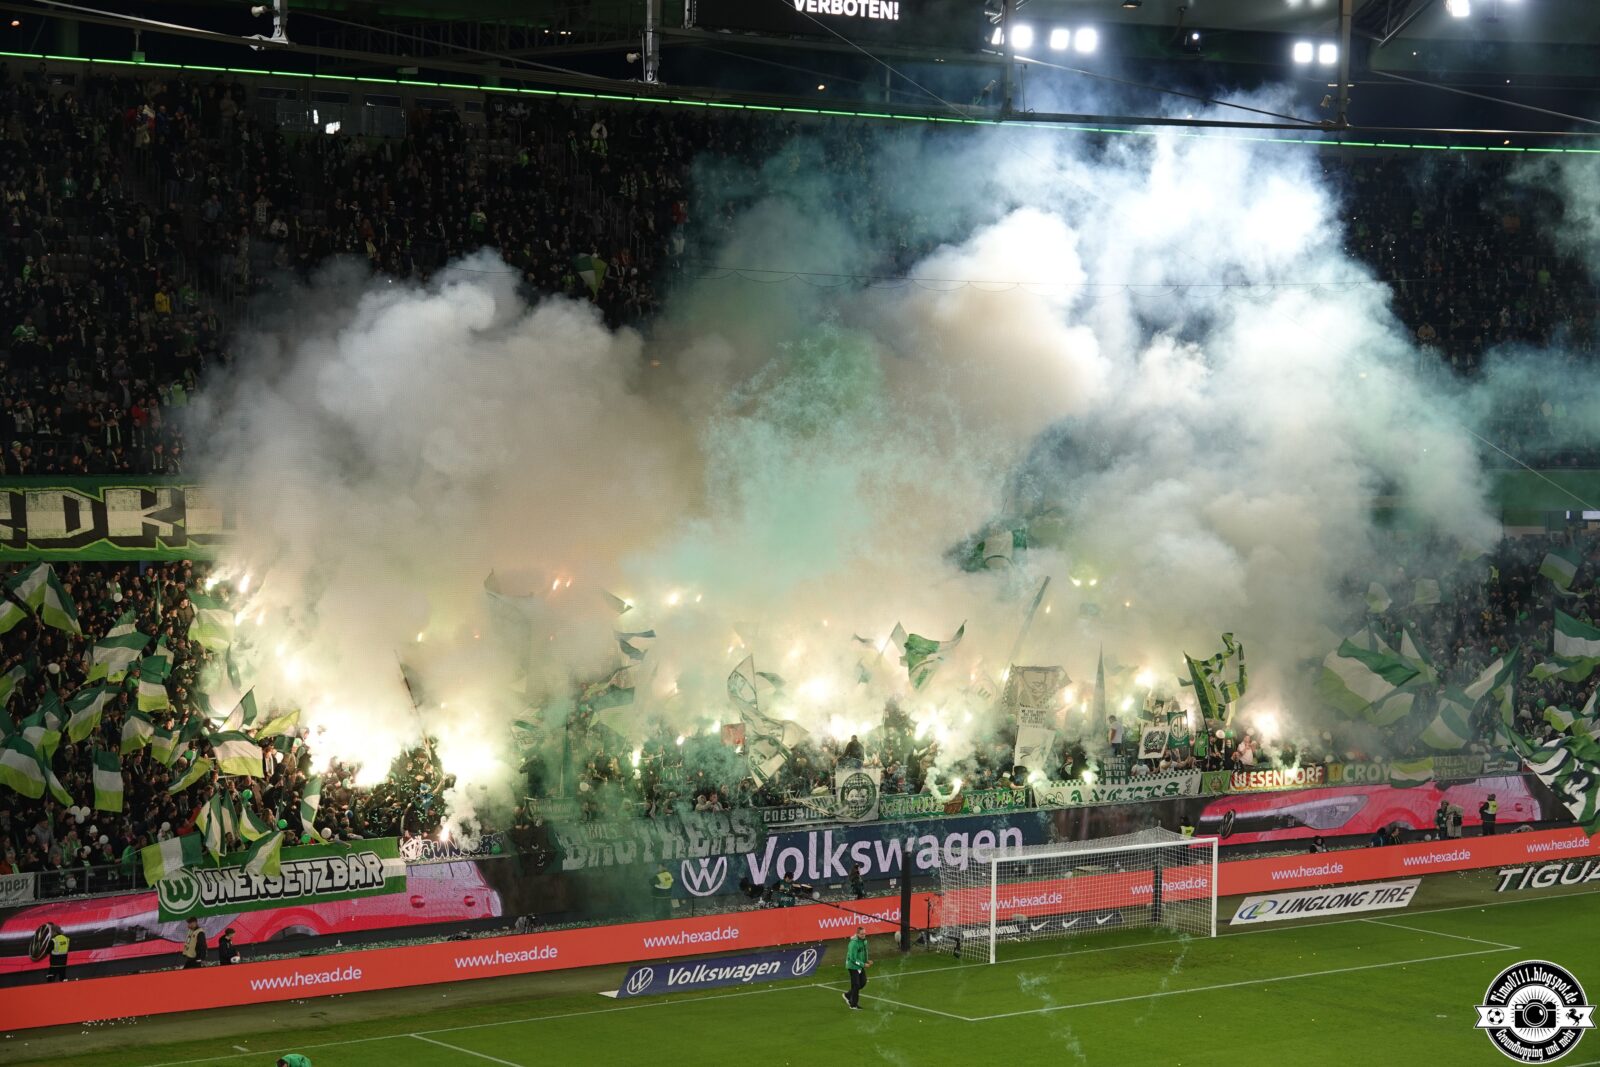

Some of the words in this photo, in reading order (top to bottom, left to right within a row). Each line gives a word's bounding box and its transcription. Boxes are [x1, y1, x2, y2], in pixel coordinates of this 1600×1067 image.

[793, 0, 899, 20] VERBOTEN!
[421, 831, 506, 860] JUNORS
[747, 826, 1024, 886] Volkswagen
[1526, 837, 1590, 853] www.hexad.de
[1403, 849, 1471, 866] www.hexad.de
[1271, 862, 1344, 880] www.hexad.de
[1131, 877, 1208, 896] wwwhexad.de
[1276, 890, 1370, 915] LINGLONG
[1367, 885, 1412, 904] TIRE
[818, 907, 901, 929] www.hexad.d
[643, 926, 740, 948] www.hexad.de
[454, 945, 559, 969] www.hexad.de
[250, 966, 363, 991] www.hexad.de
[667, 959, 782, 986] Volkswagen
